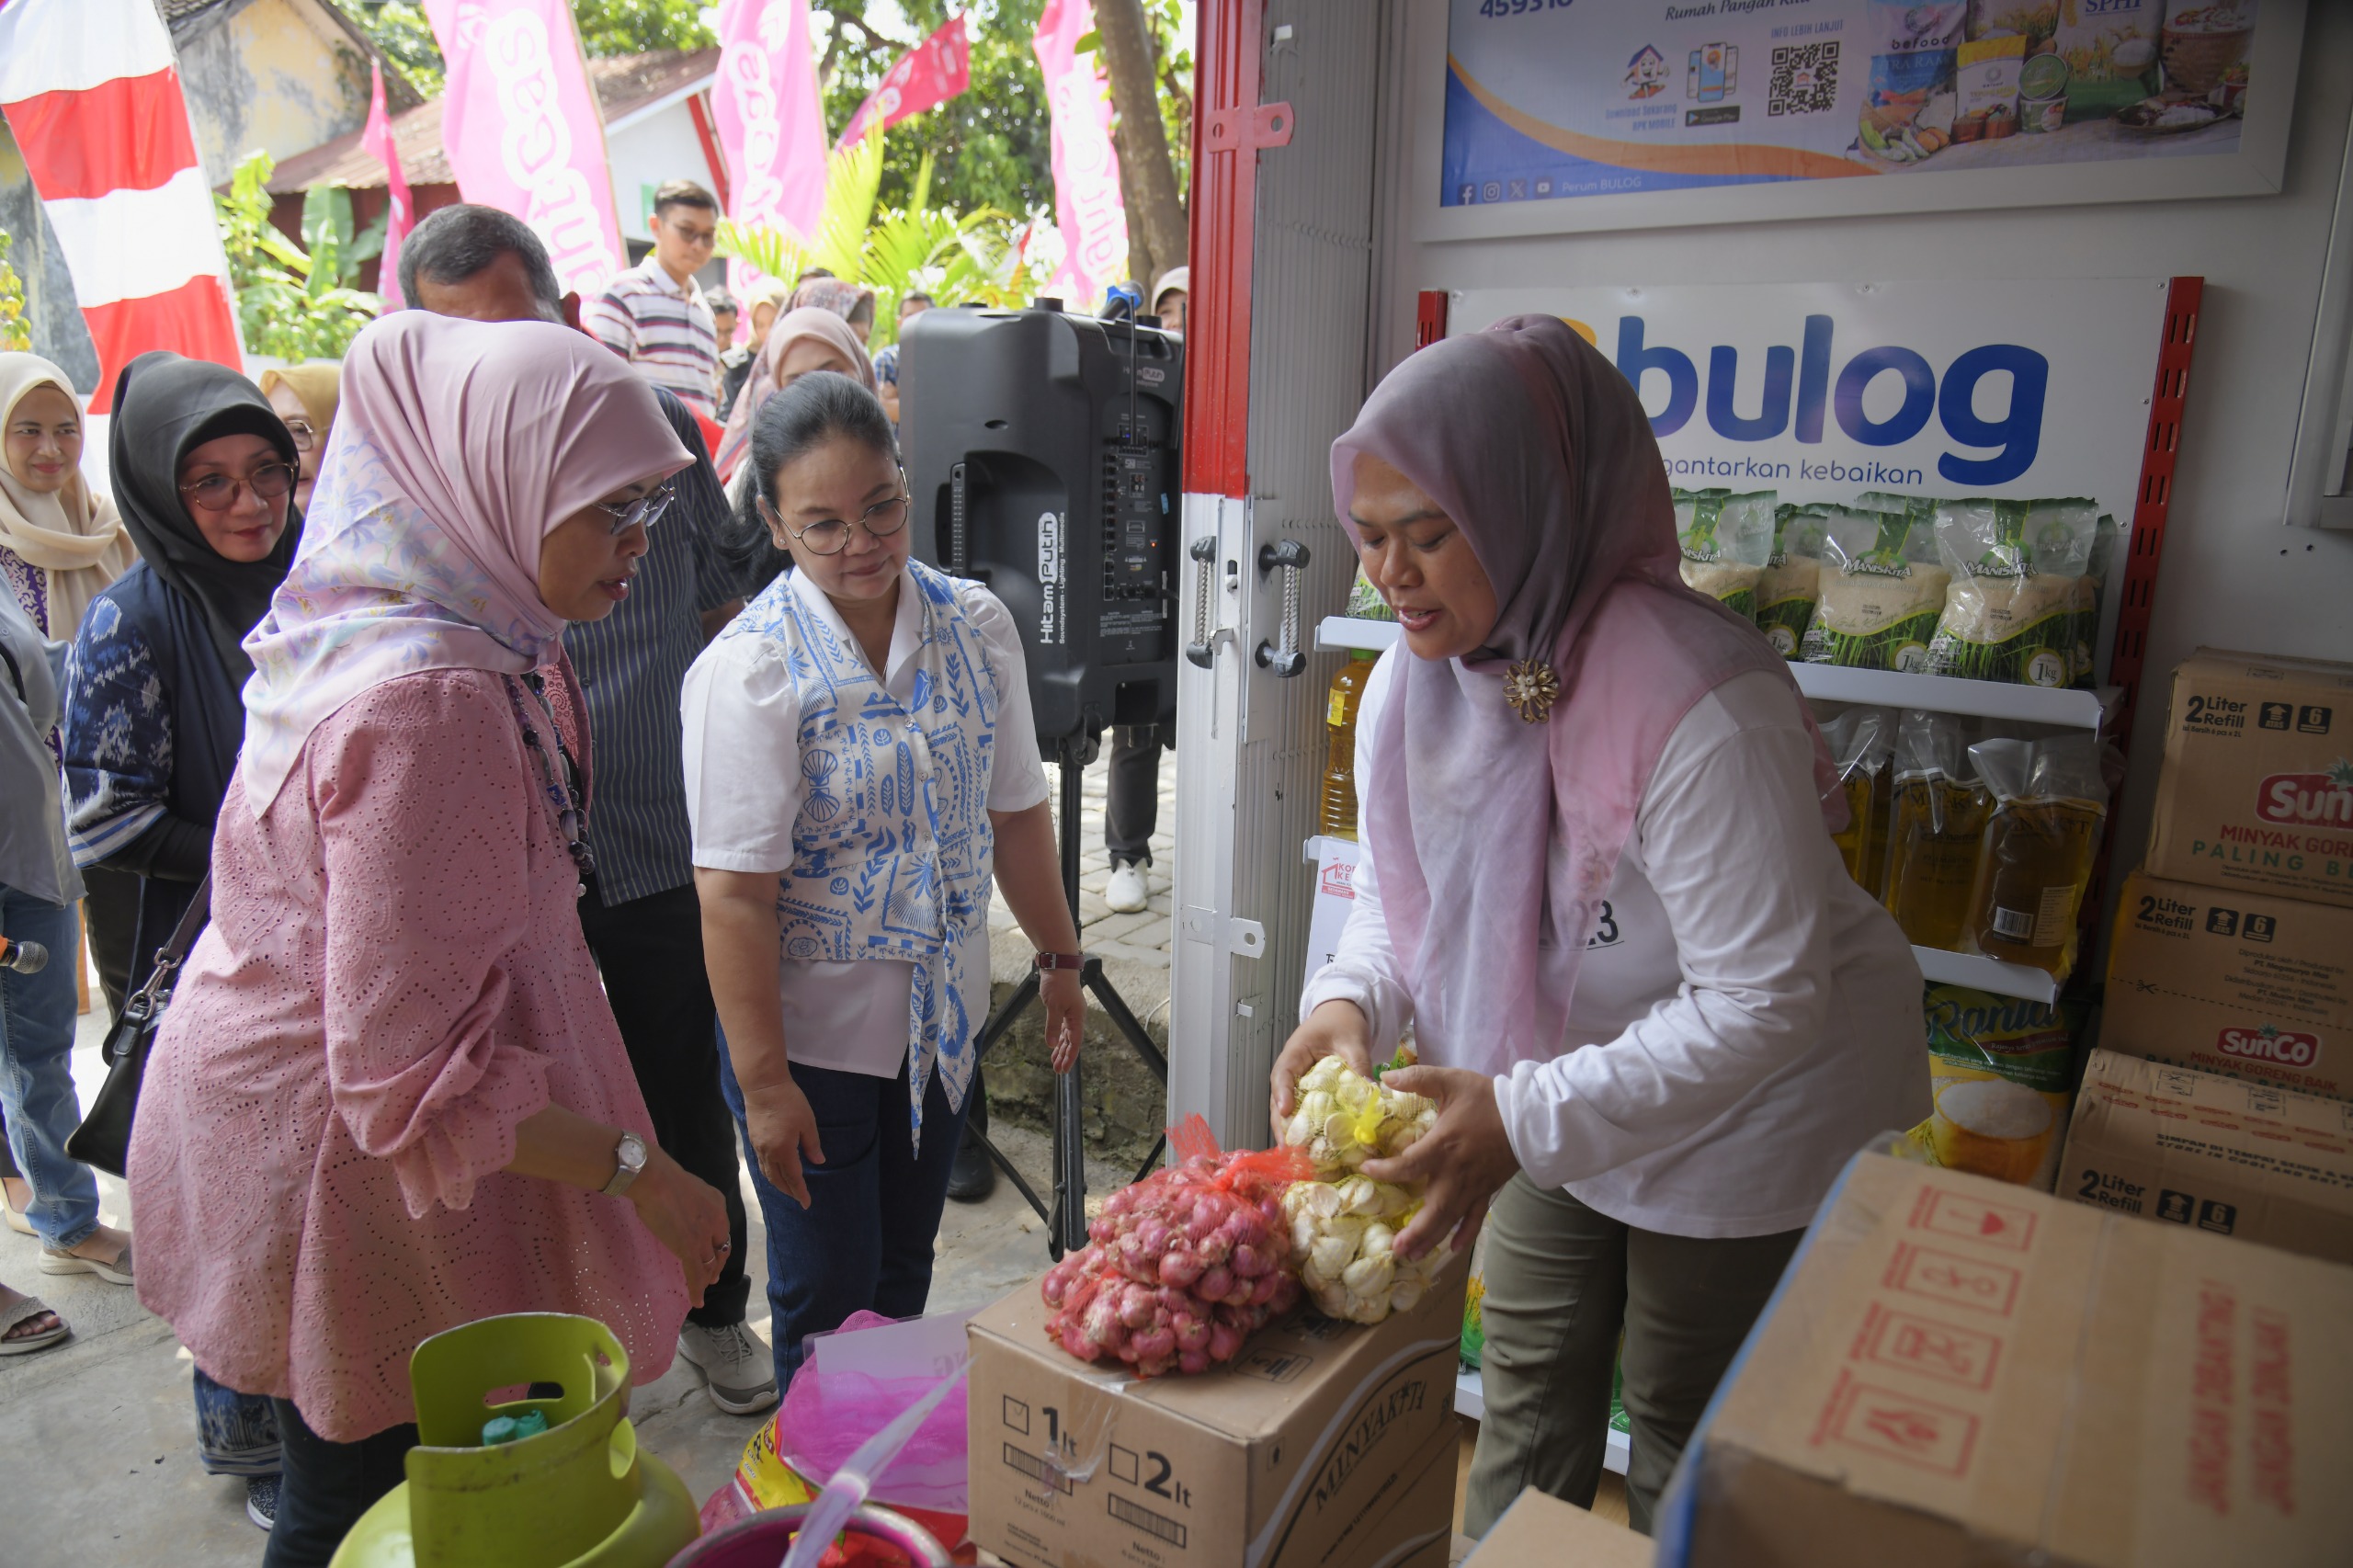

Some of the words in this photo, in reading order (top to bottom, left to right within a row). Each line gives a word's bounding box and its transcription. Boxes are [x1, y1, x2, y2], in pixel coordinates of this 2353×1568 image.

[1665, 4, 1716, 20] Rumah
[1721, 0, 1775, 14] Pangan
[1770, 26, 1788, 38] INFO
[1790, 23, 1813, 37] LEBIH
[1814, 19, 1844, 34] LANJUT
[1892, 36, 1951, 51] befood
[1648, 118, 1676, 129] MOBILE
[1562, 181, 1597, 193] Perum
[1600, 176, 1642, 190] BULOG
[1617, 314, 2049, 485] bulog
[1664, 457, 1790, 479] gantarkan
[1801, 459, 1923, 484] kebaikan
[1040, 517, 1054, 580] Putih
[1040, 585, 1054, 644] Hitam
[2185, 696, 2204, 723] 2
[2207, 697, 2247, 713] Liter
[2310, 708, 2324, 725] 6
[2203, 713, 2245, 728] Refill
[2267, 780, 2353, 823] Sun
[2220, 824, 2301, 850] MINYAK
[2305, 836, 2353, 858] GOR
[2192, 840, 2304, 872] PALING
[2137, 895, 2155, 921] 2
[2157, 898, 2196, 916] Liter
[2154, 915, 2193, 931] Refill
[2223, 1030, 2311, 1063] SunCo
[2191, 1051, 2242, 1071] MINYAK
[2244, 1062, 2302, 1083] GORENG
[2304, 1075, 2339, 1092] BAIK
[2155, 1140, 2202, 1154] STORE
[2207, 1151, 2222, 1159] IN
[2228, 1156, 2266, 1169] COOL
[2272, 1165, 2303, 1177] AND
[2156, 1132, 2207, 1148] SIMPAN
[2210, 1143, 2223, 1152] DI
[2226, 1148, 2277, 1165] TEMPAT
[2079, 1169, 2100, 1199] 2
[2101, 1173, 2146, 1198] Liter
[2097, 1190, 2143, 1214] Refill
[1025, 1488, 1050, 1508] Netto
[1132, 1541, 1161, 1562] Netto
